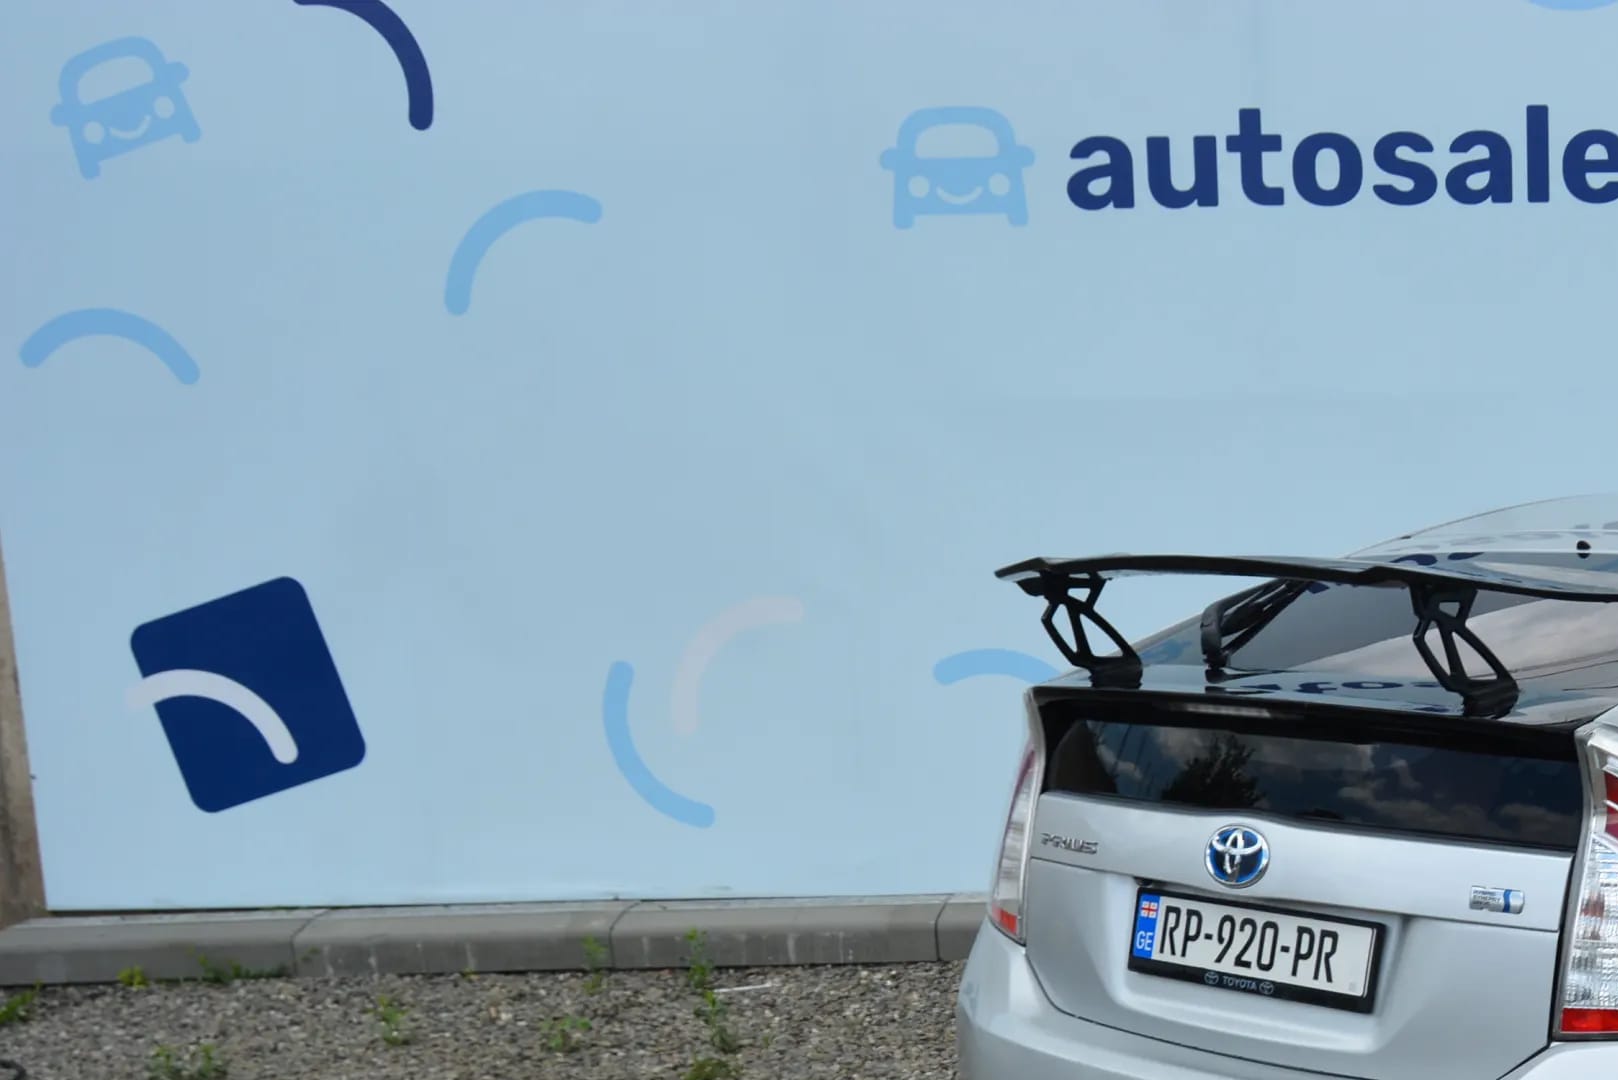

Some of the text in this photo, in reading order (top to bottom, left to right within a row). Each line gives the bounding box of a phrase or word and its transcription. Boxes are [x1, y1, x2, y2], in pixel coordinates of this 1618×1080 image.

[1136, 930, 1154, 951] GE
[1159, 904, 1339, 984] RP-920-PR
[1222, 975, 1258, 991] TOYOTA
